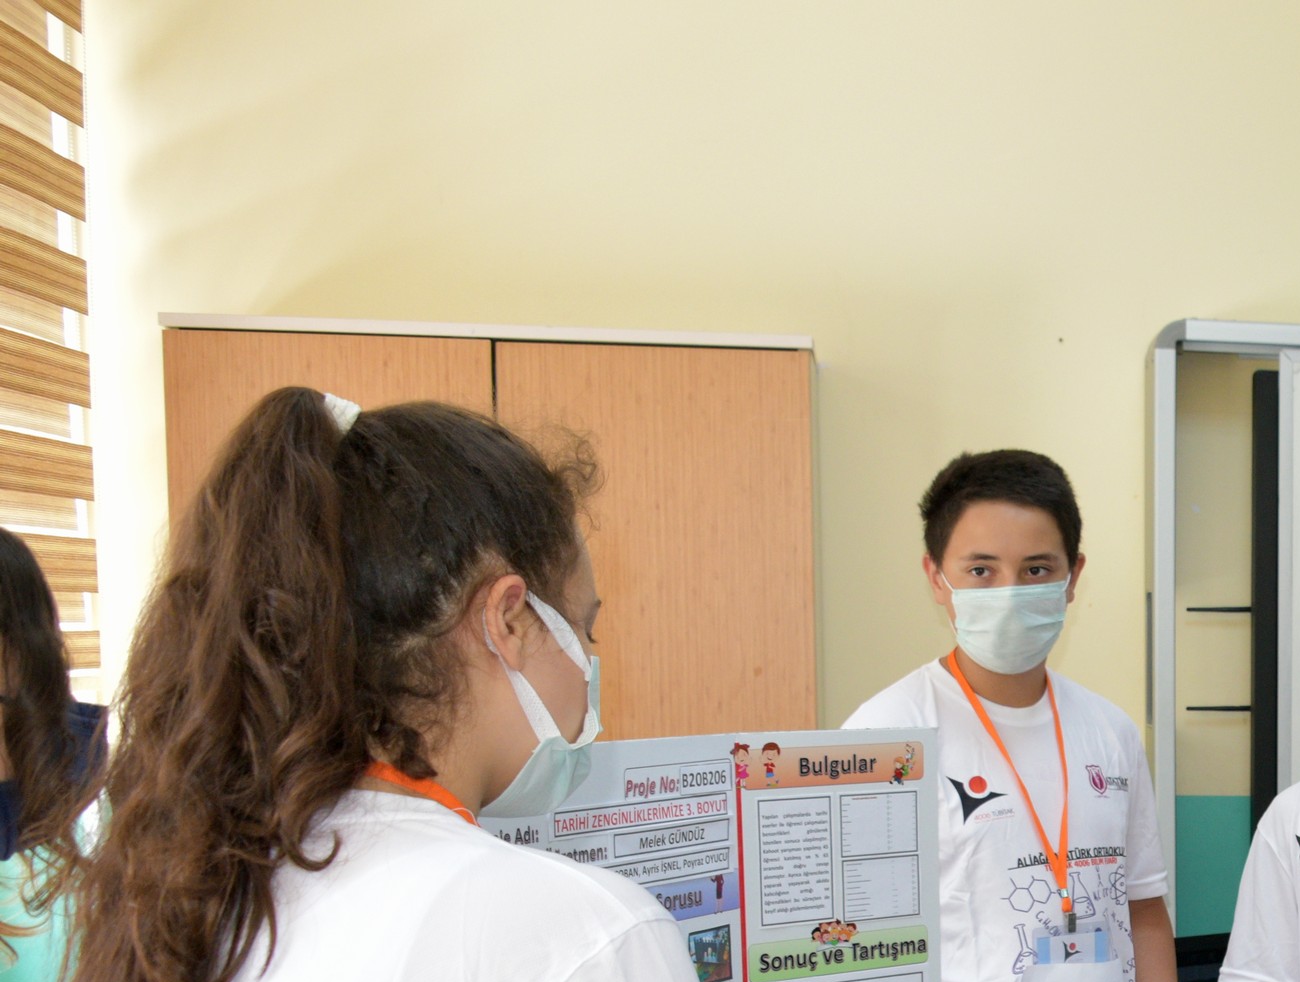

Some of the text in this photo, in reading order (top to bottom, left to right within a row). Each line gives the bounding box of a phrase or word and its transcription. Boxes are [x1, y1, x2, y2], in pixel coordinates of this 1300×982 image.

[799, 753, 877, 780] Bulgular
[624, 769, 727, 799] Proje No: B20B206
[555, 799, 727, 833] TARİHİ ZENGİNLİKLERİMİZE 3. BOYUT
[514, 825, 539, 845] Adı:
[639, 828, 705, 850] Melek GÜNDÜZ
[683, 857, 704, 870] Poyraz
[705, 853, 728, 865] OYUCU
[655, 890, 703, 909] Sorusu
[759, 938, 928, 974] Sonuç ve Tartışma
